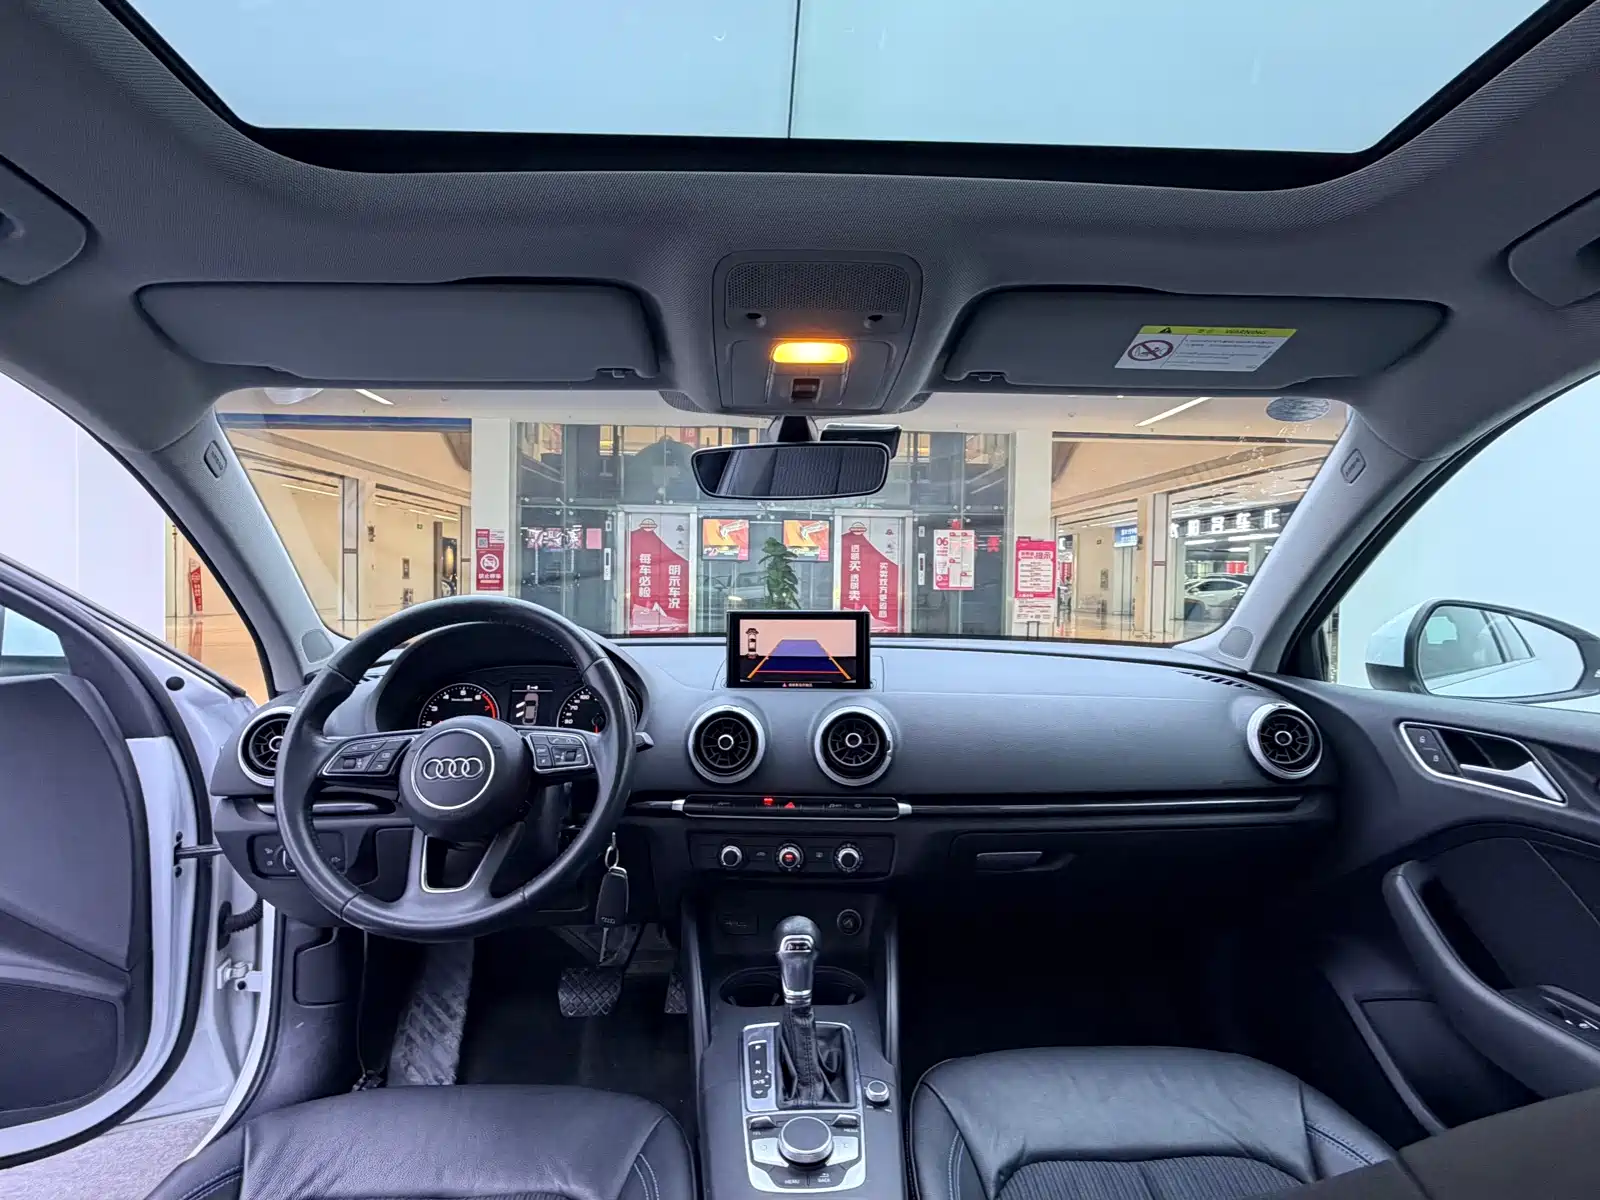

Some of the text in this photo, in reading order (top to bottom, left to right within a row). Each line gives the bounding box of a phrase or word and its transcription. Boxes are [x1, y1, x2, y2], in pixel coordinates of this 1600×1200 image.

[936, 537, 949, 546] 06
[639, 553, 651, 598] 每车必检
[668, 565, 681, 608] 明示车况
